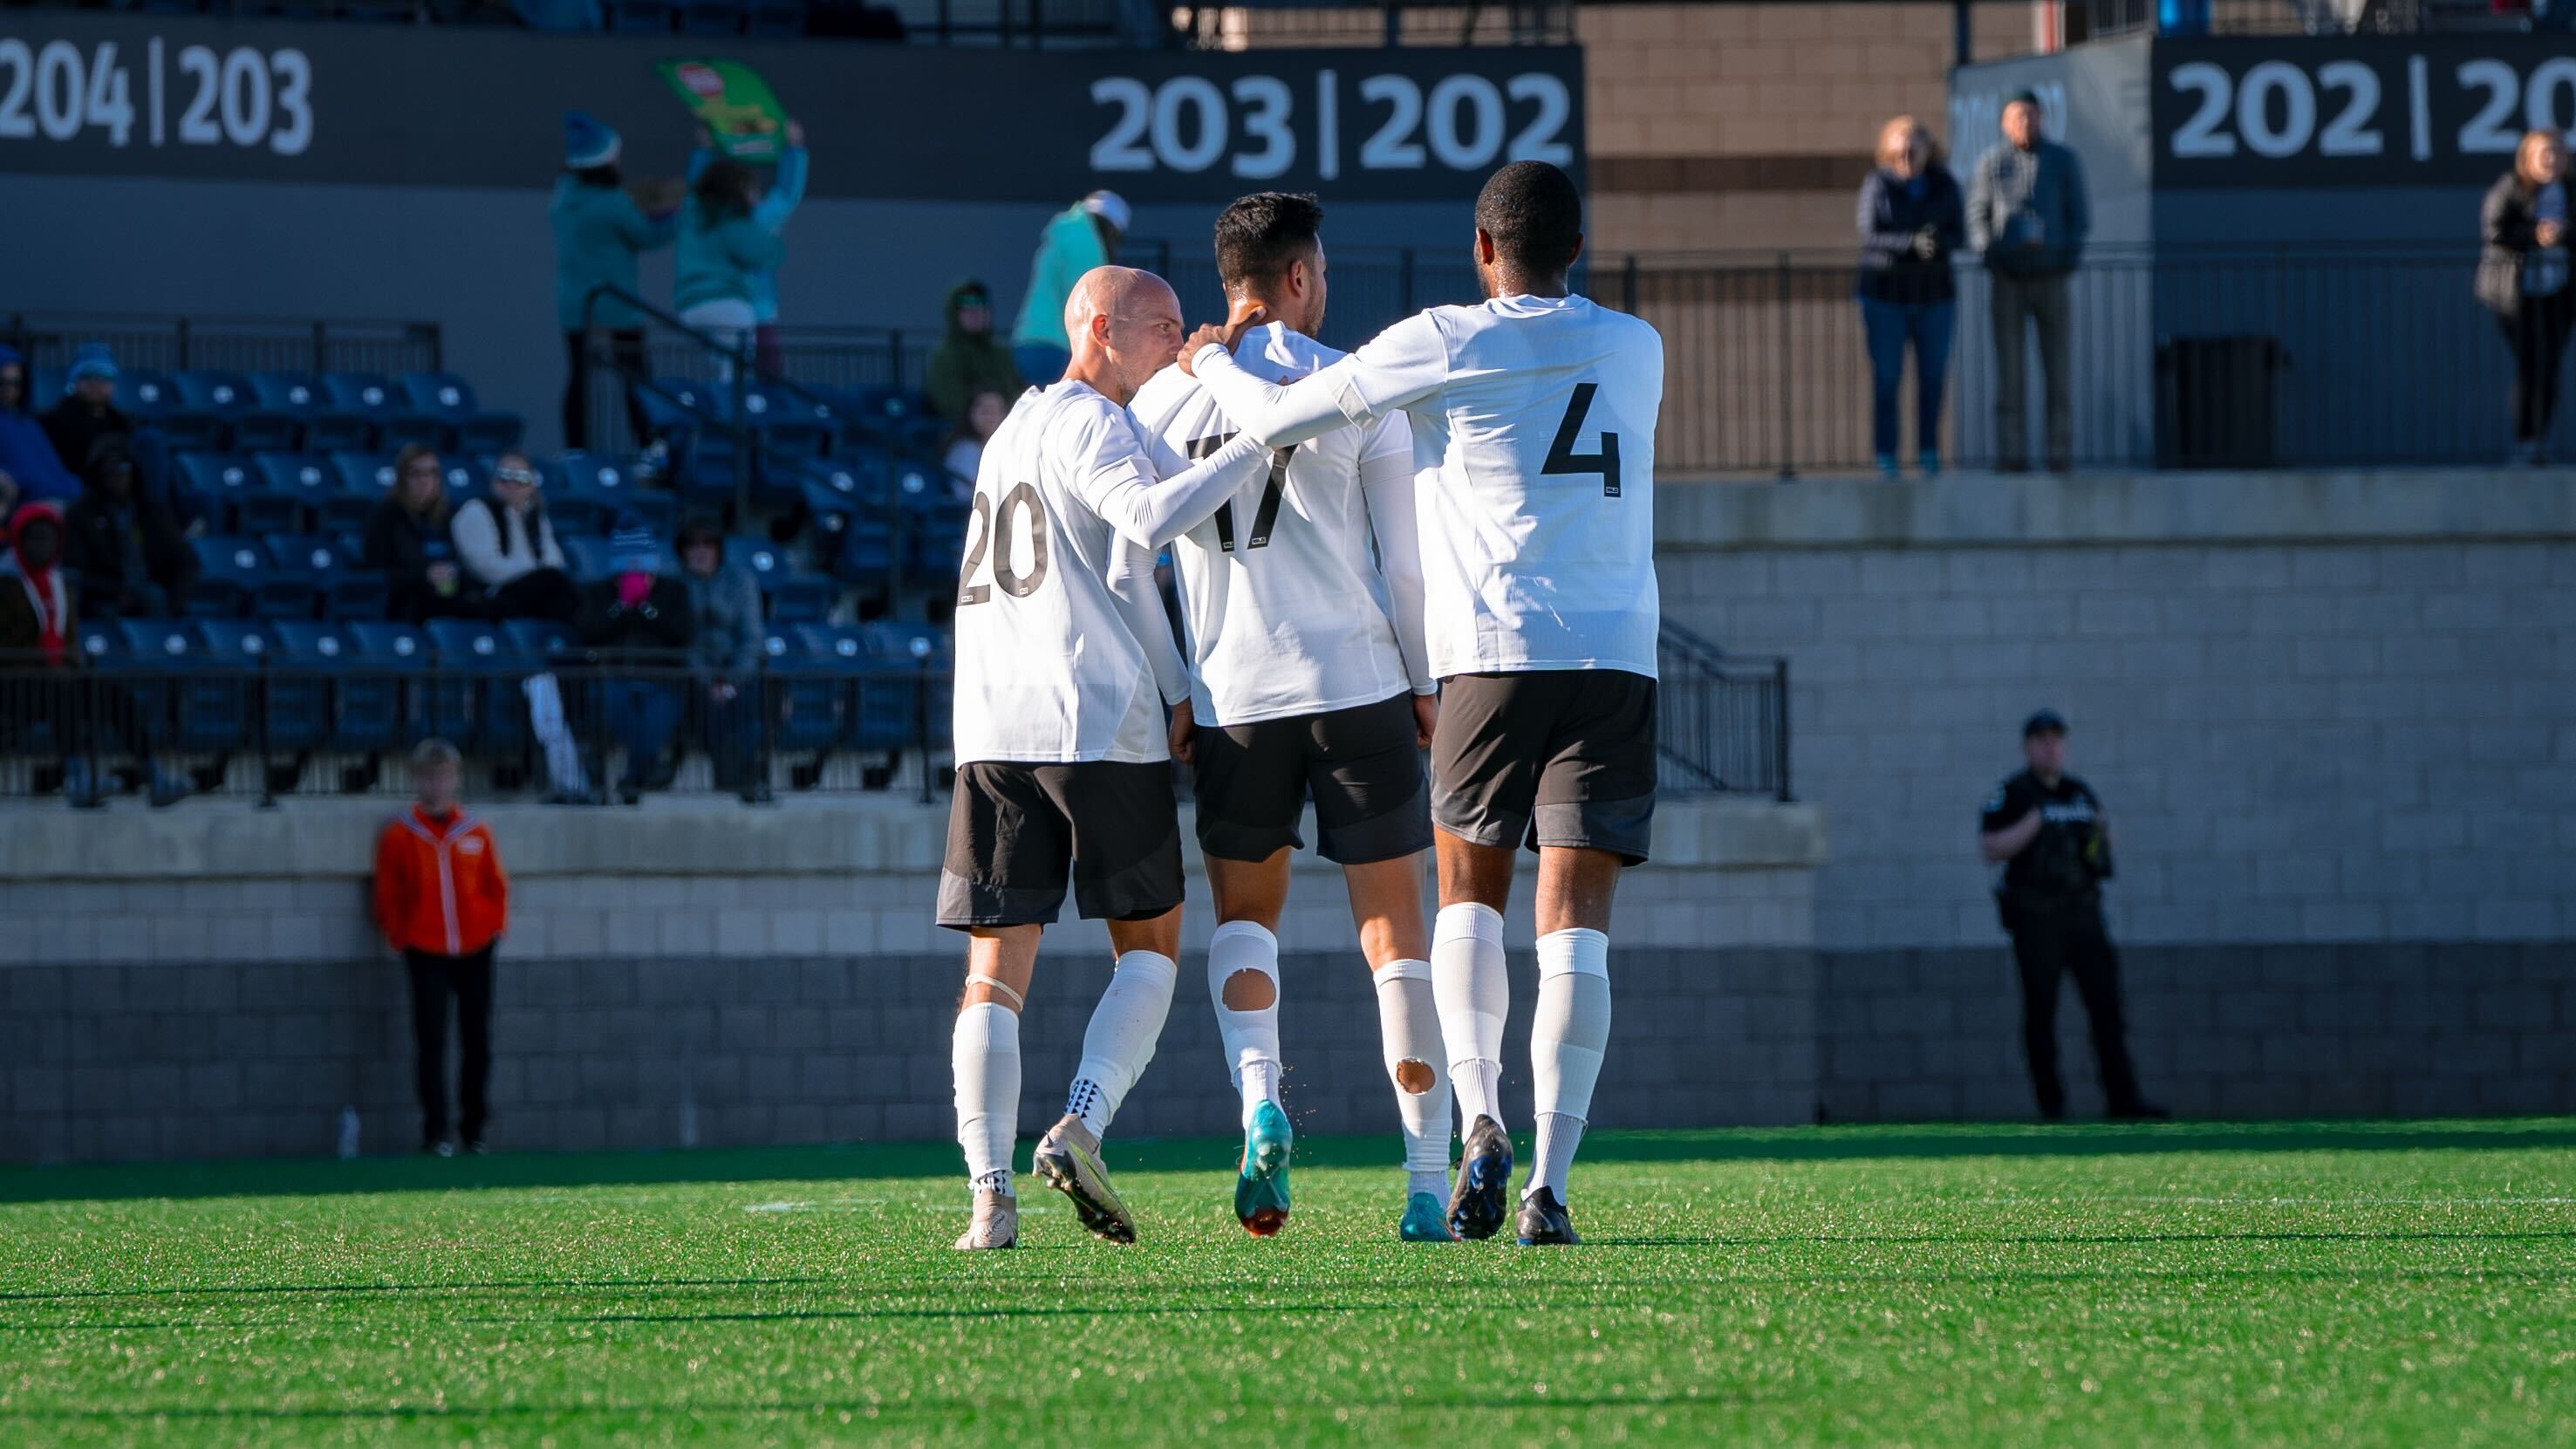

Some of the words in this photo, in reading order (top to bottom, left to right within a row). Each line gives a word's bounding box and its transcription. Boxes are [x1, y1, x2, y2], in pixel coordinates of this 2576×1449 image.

[0, 38, 135, 147] 204
[177, 44, 313, 155] 203
[1090, 76, 1297, 180] 203
[1357, 72, 1573, 170] 202
[2168, 59, 2384, 158] 202
[1540, 382, 1621, 497] 4
[957, 482, 1048, 606] 20
